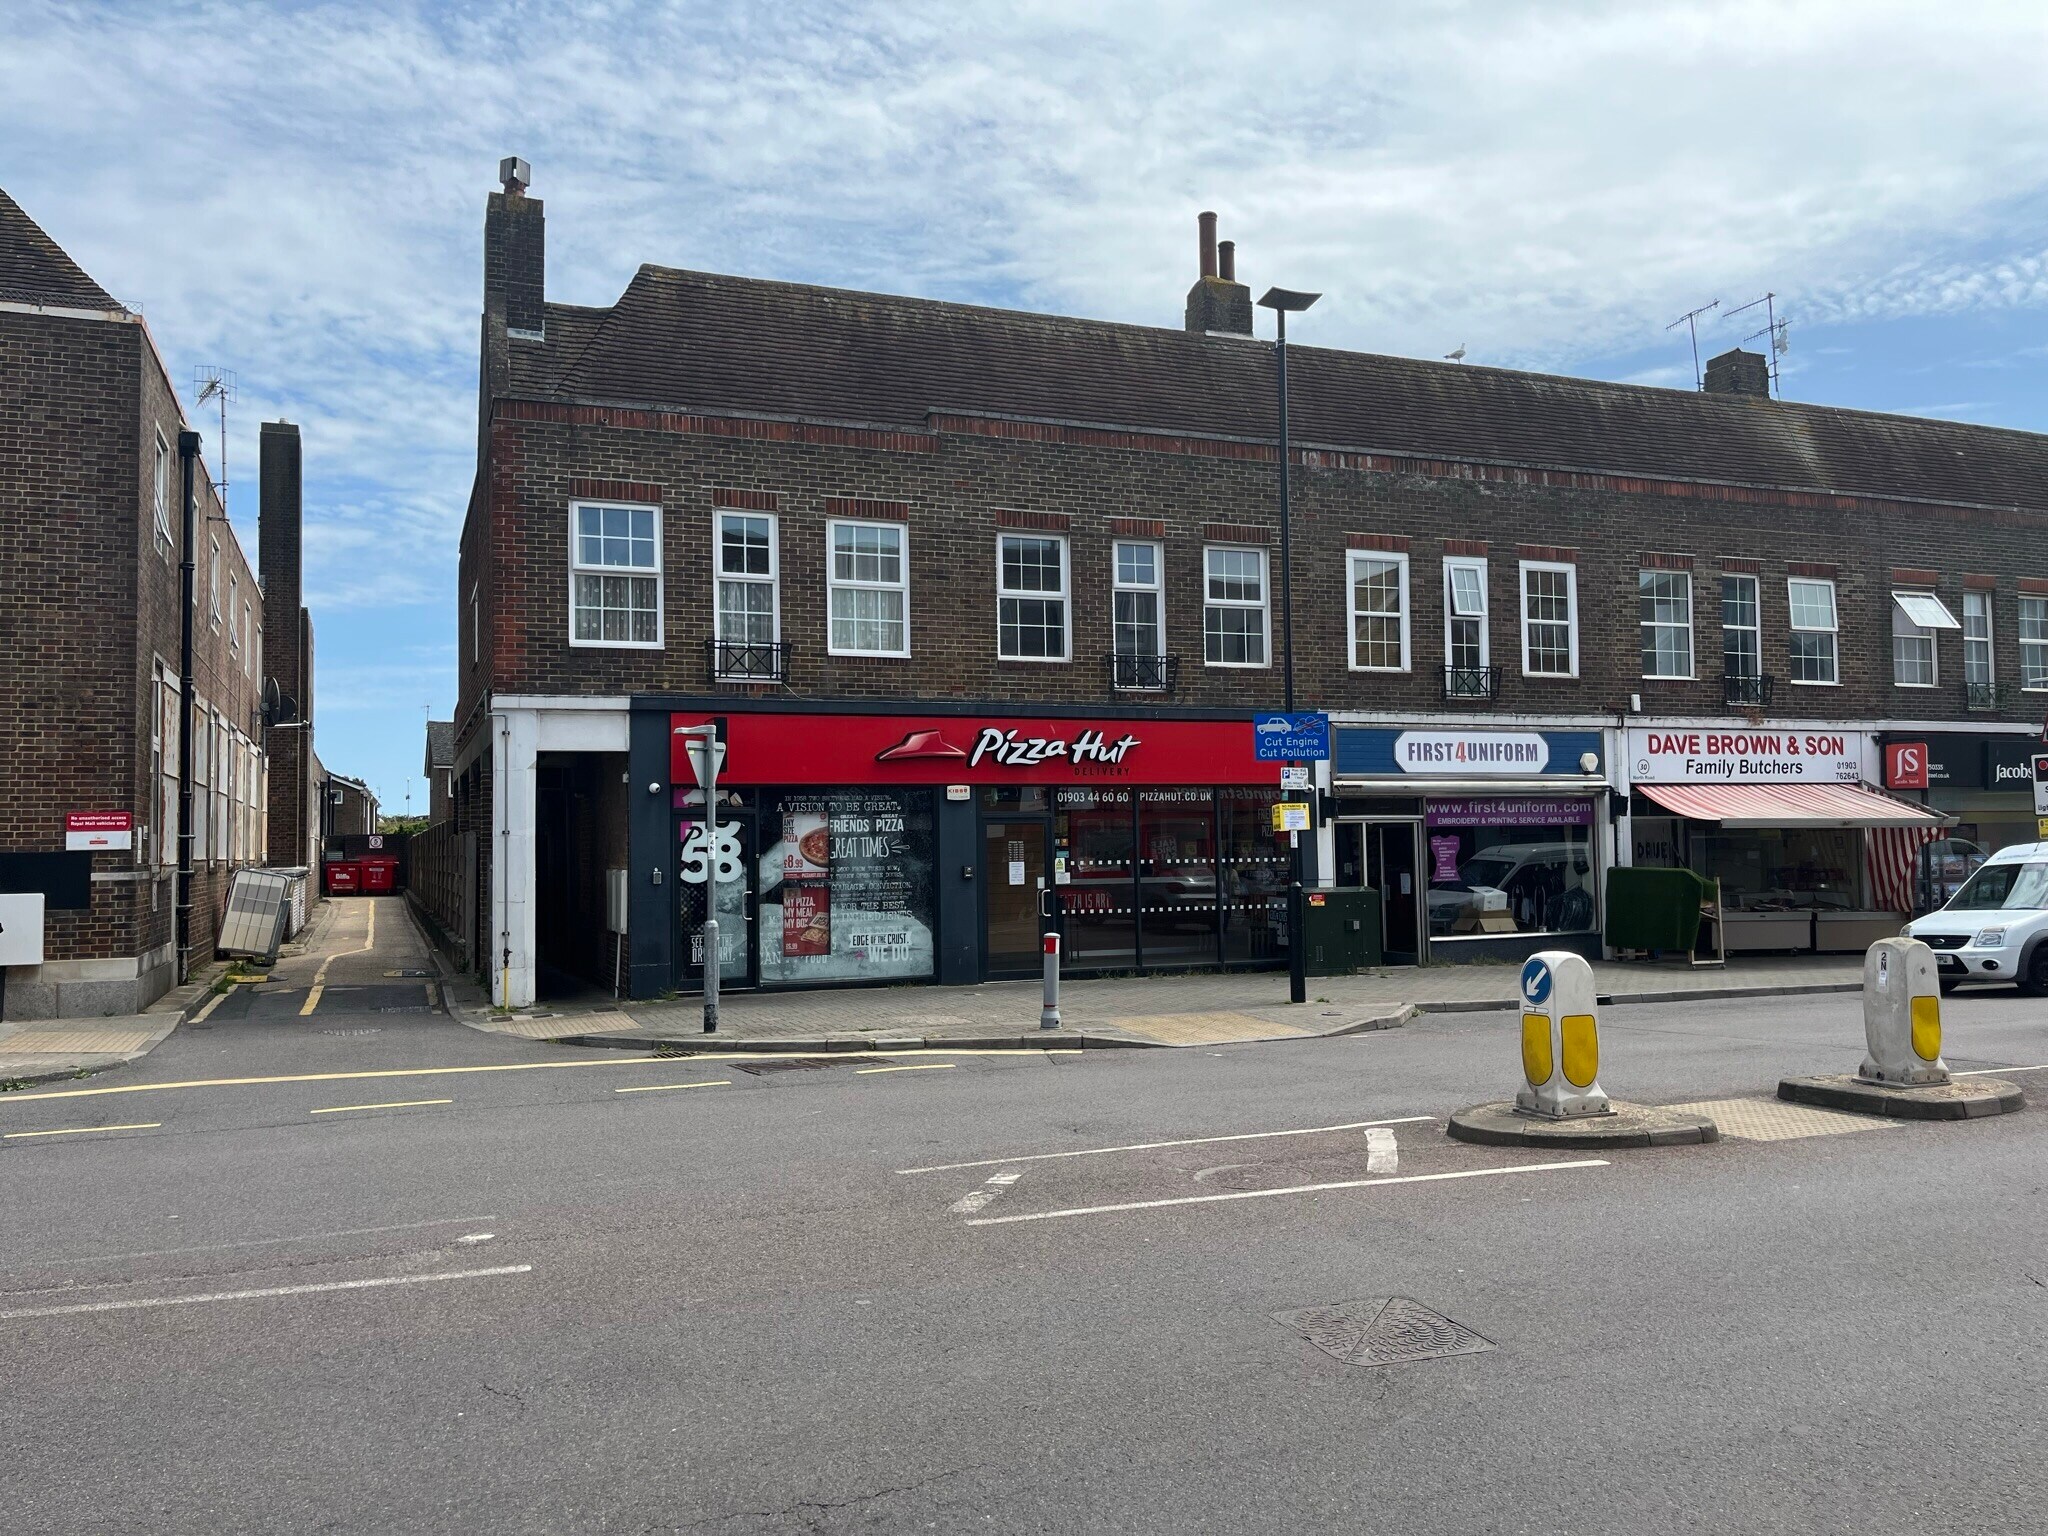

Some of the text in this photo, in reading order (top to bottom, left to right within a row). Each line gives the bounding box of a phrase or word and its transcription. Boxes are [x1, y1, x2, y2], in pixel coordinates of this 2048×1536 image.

[969, 728, 1142, 767] Pizza Hut
[1264, 737, 1319, 747] Cut Engine
[1647, 734, 1844, 756] DAVE BROWN & SON
[1260, 748, 1325, 757] Cut Pollution
[1686, 759, 1803, 778] Family Butchers
[1836, 761, 1857, 770] 01903
[1074, 767, 1130, 776] DELIVERY
[1835, 772, 1859, 781] 762643
[1057, 792, 1129, 803] 01903 44 60 60
[1139, 791, 1212, 802] PIZZAHUT.CO.UK
[776, 801, 901, 812] A VISION TO BE GREAT.
[783, 818, 794, 827] ANY
[829, 818, 904, 833] FRIENDS PIZZA
[1437, 817, 1480, 825] EMBROIDERY
[1481, 817, 1486, 825] &
[1487, 817, 1517, 825] PRINTING
[1518, 816, 1545, 824] SERVICE
[783, 826, 795, 835] SIZE
[783, 834, 799, 843] PIZZA
[859, 836, 890, 858] TIMES
[783, 855, 804, 868] £8.99
[784, 896, 816, 907] MY PIZZA.
[841, 903, 857, 911] FOR
[861, 902, 879, 910] THE
[784, 907, 795, 918] MY
[784, 918, 795, 929] MY
[691, 937, 703, 948] SEE
[721, 936, 733, 947] THE
[852, 935, 869, 946] EDGE
[870, 935, 877, 944] OF
[877, 935, 886, 944] THE
[868, 945, 889, 962] WE
